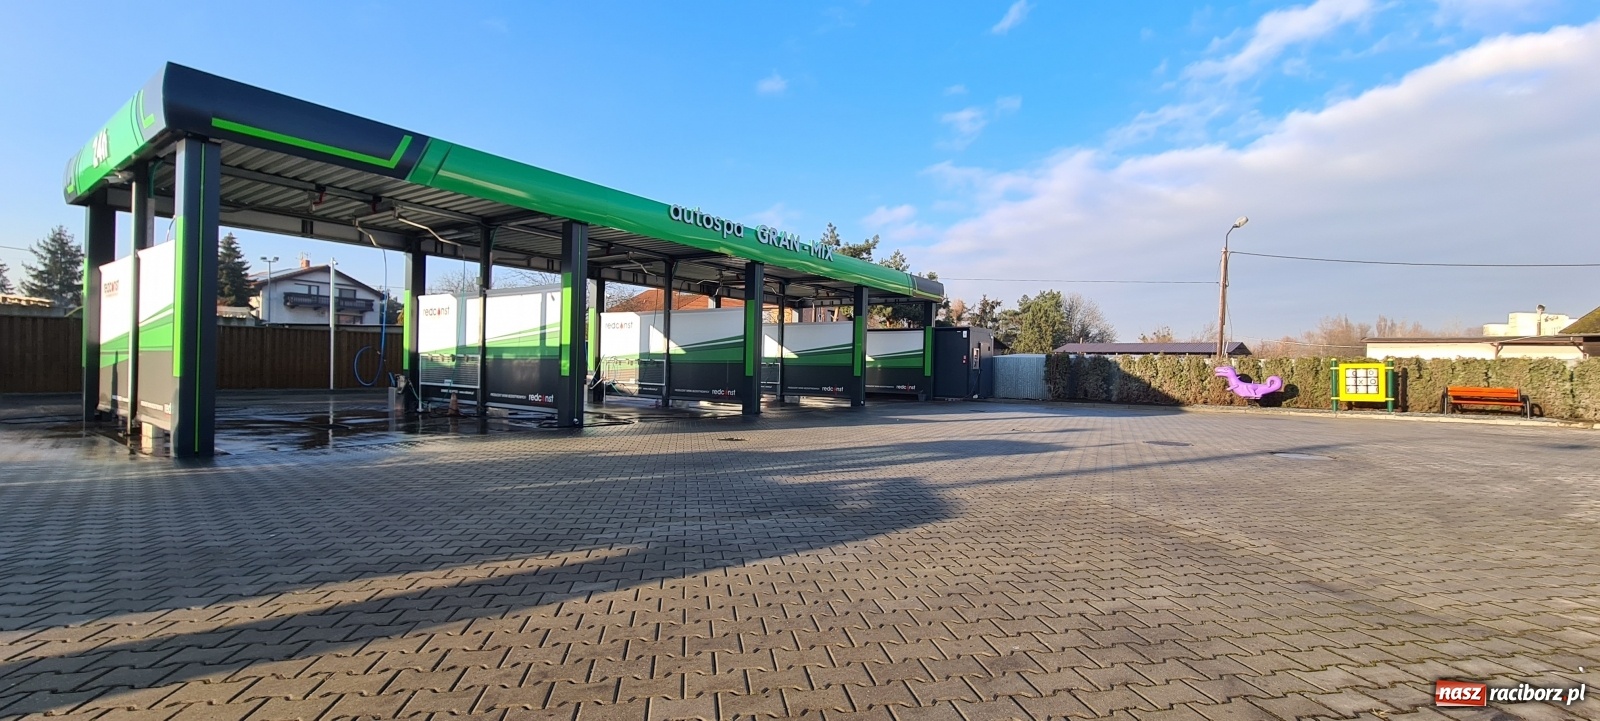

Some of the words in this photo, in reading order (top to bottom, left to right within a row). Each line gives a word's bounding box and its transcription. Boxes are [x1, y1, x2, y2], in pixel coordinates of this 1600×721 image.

[669, 203, 744, 239] autospa
[756, 224, 800, 252] GRAN
[809, 239, 834, 262] MIX
